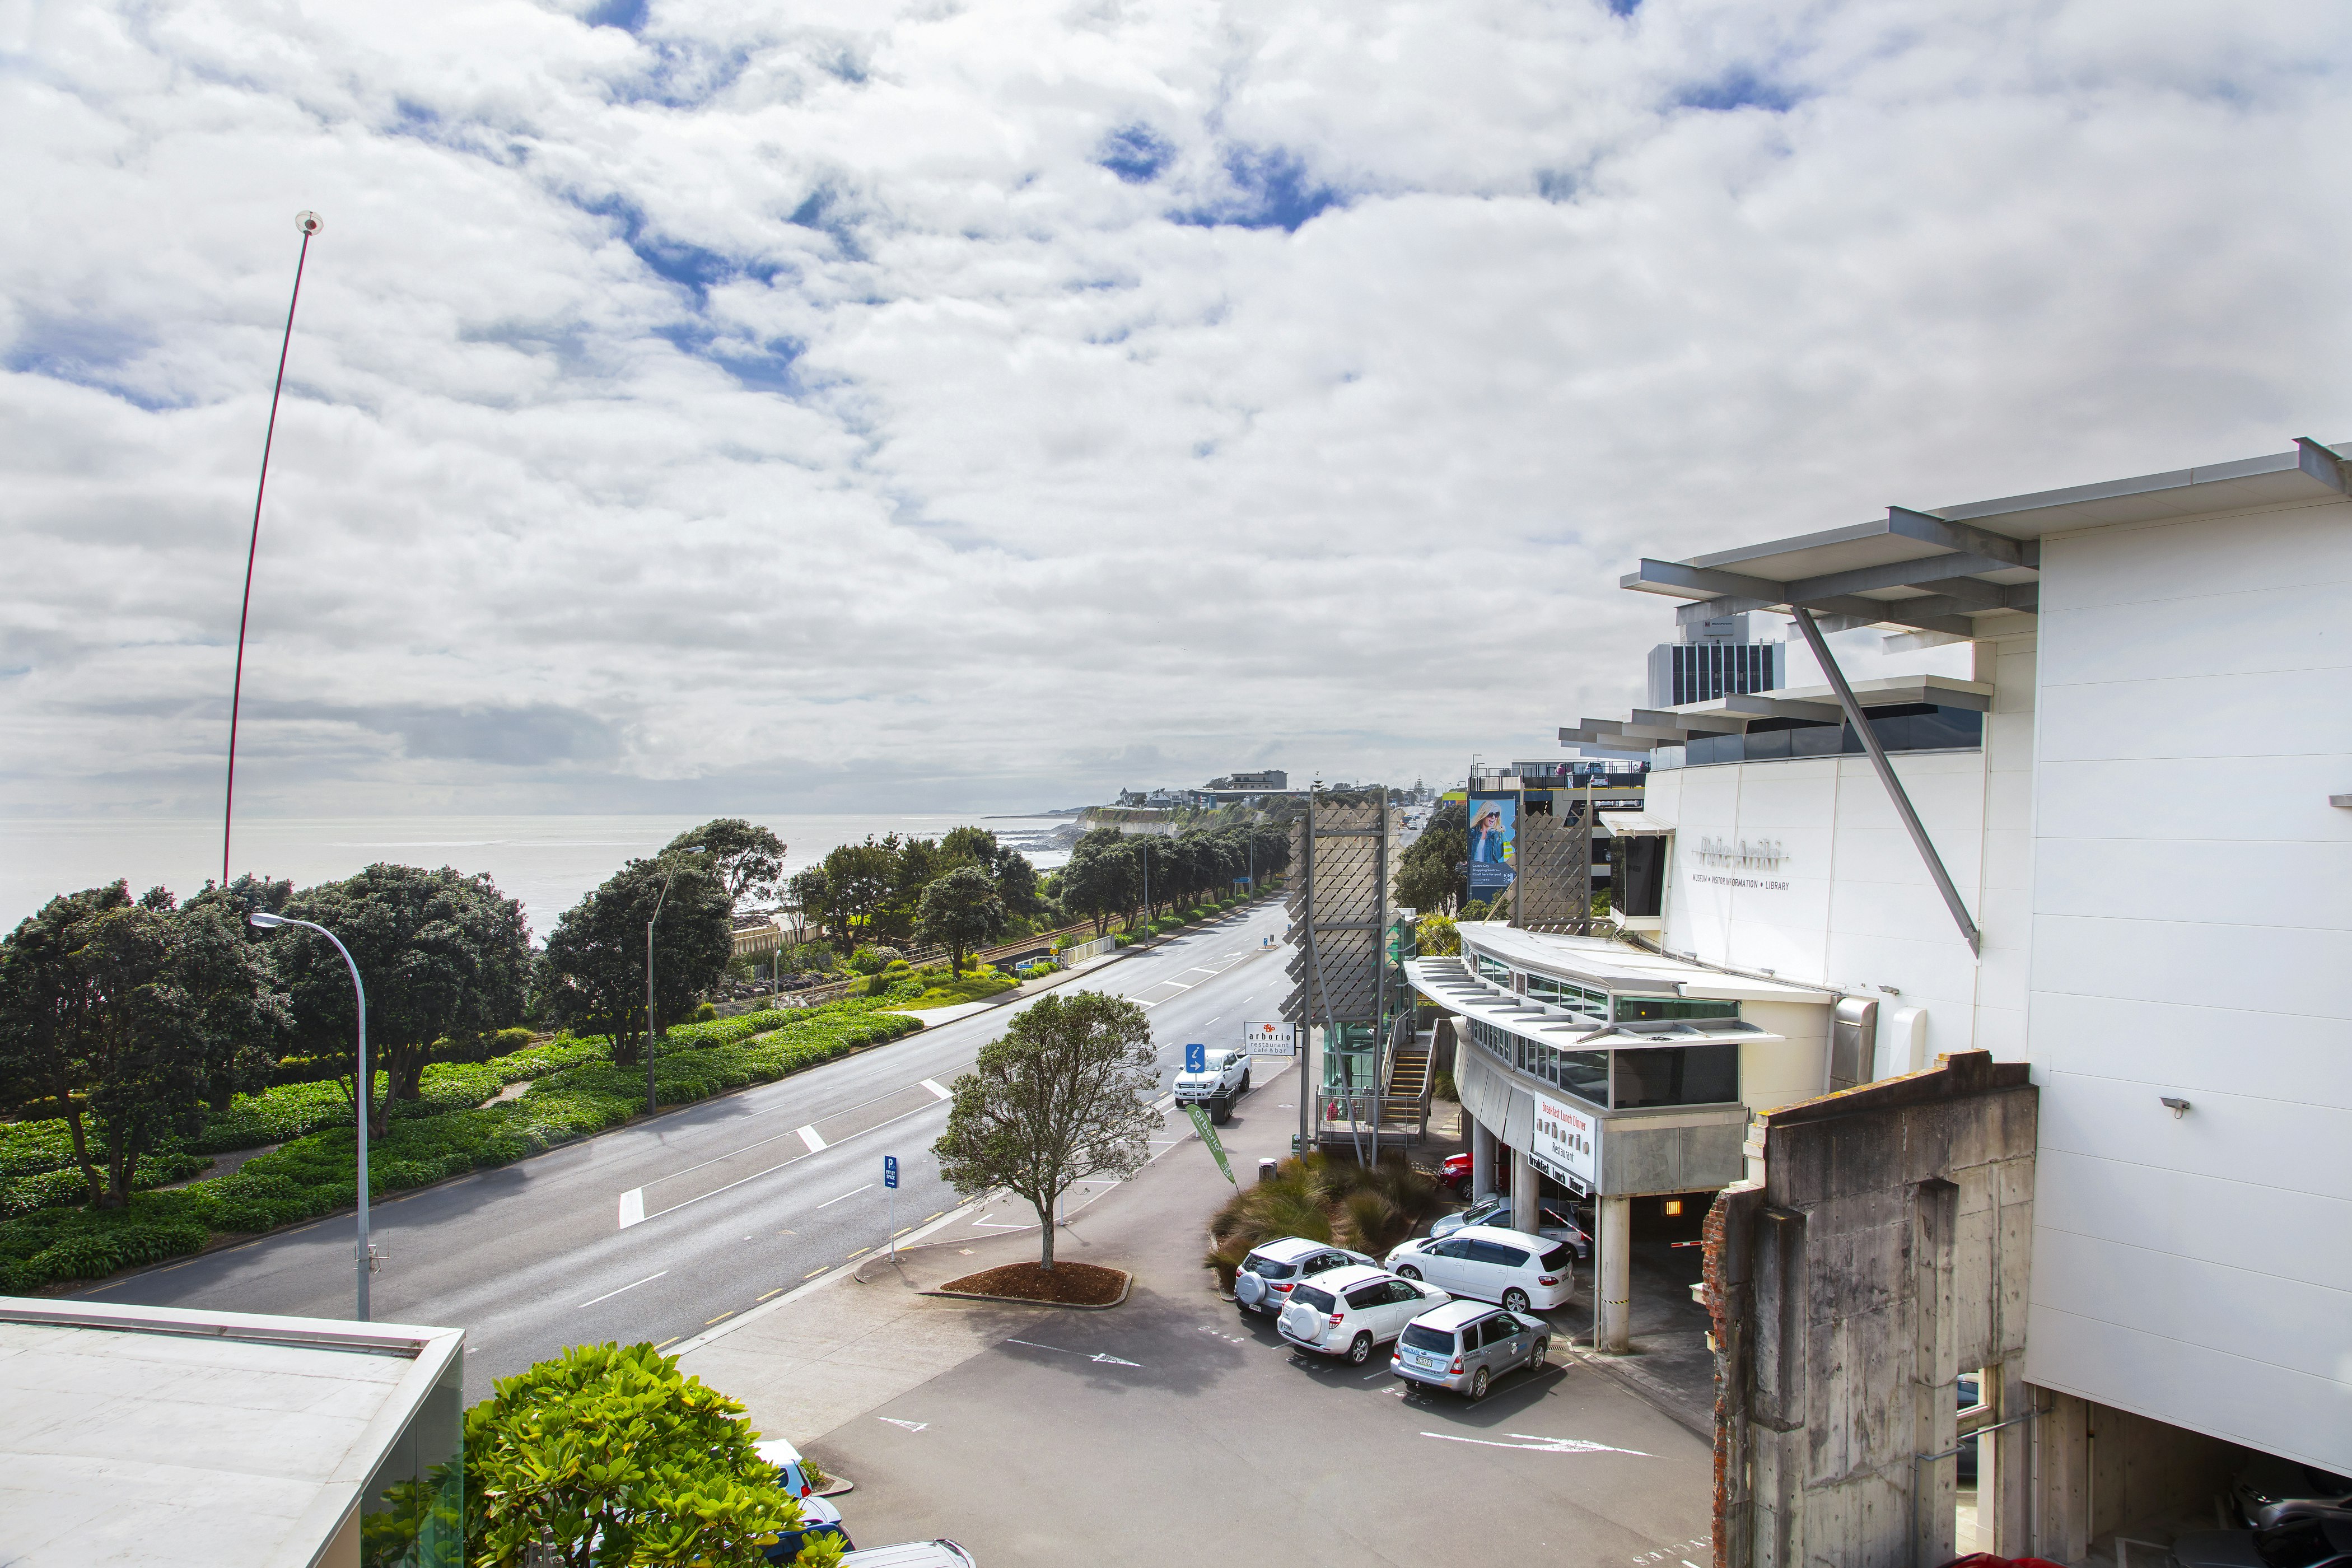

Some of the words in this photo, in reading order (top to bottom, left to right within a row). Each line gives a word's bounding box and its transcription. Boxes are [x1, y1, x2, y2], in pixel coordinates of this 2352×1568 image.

[1699, 836, 1729, 866] Puke
[1734, 838, 1779, 871] Ariki
[1692, 874, 1707, 883] MUSEUM
[1712, 876, 1725, 885] VISITOR
[1725, 878, 1758, 888] INFORMATION
[1765, 881, 1789, 890] LIBRARY
[1193, 1114, 1205, 1136] RESTAURANT
[1542, 1101, 1560, 1119] Breakfast
[1561, 1110, 1572, 1125] Lunch
[1573, 1116, 1586, 1131] Dinner
[1195, 1110, 1220, 1151] arborio
[1537, 1118, 1589, 1155] arborio
[1552, 1141, 1574, 1163] Restaurant
[888, 1158, 893, 1169] P
[1529, 1154, 1550, 1175] Breakfast
[1552, 1166, 1566, 1185] Lunch
[1569, 1176, 1584, 1194] Dinner
[1403, 1346, 1420, 1355] ROTOKARE
[1417, 1357, 1431, 1366] KCG121
[1407, 1364, 1441, 1375] www.rotokare.org.nz
